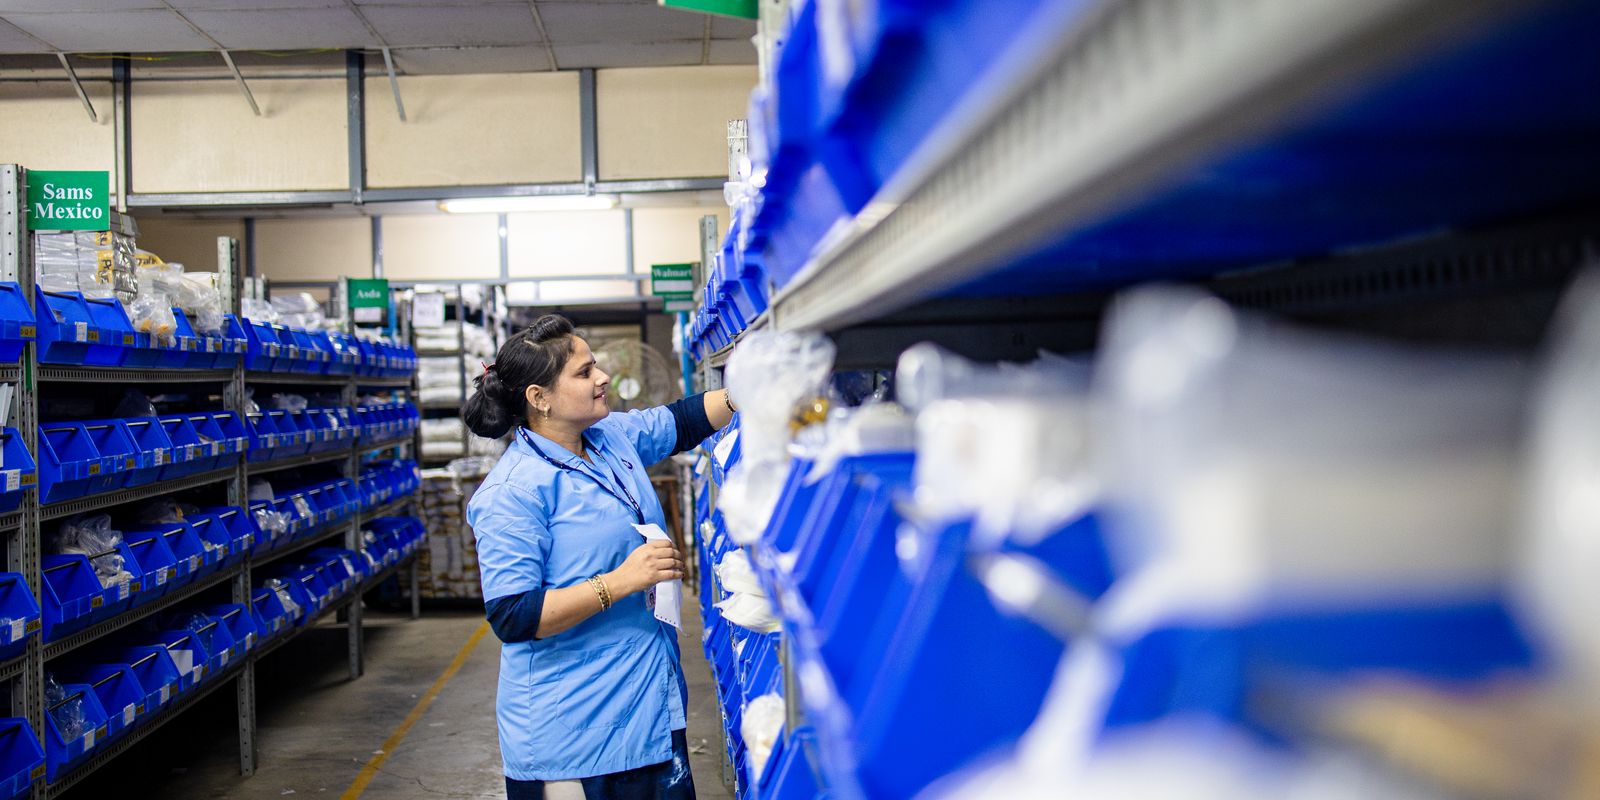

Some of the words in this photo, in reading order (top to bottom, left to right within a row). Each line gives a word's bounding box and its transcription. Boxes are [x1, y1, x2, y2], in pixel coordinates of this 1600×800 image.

[43, 182, 93, 200] Sams
[34, 202, 103, 219] Mexico
[654, 268, 692, 278] Walmart
[356, 289, 382, 299] Asda
